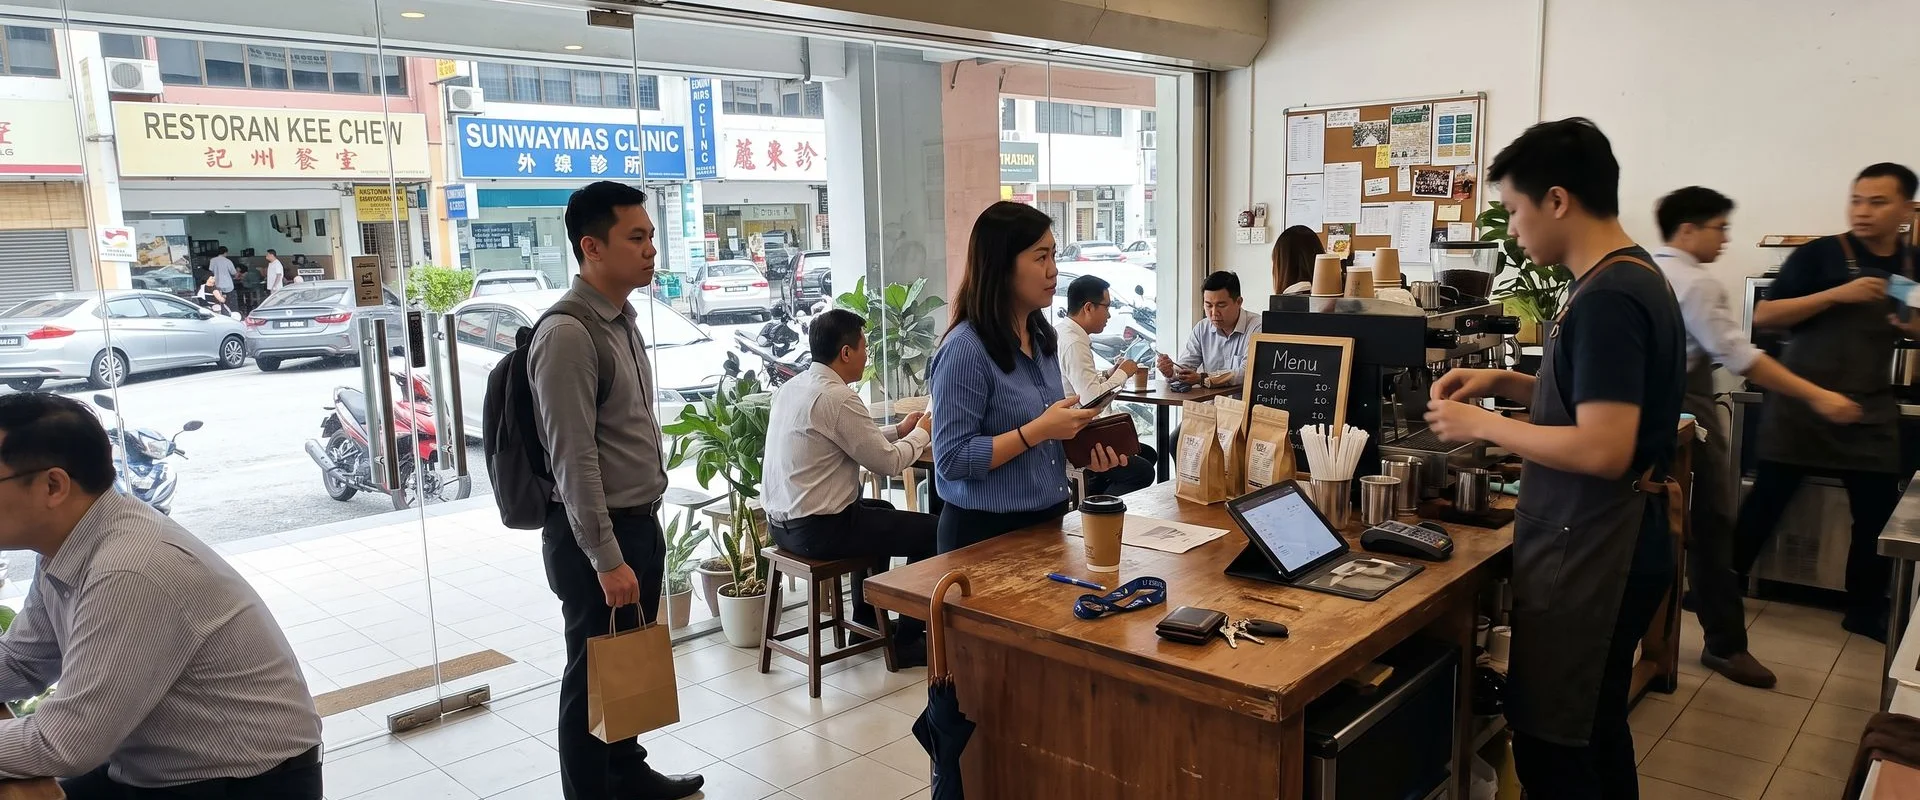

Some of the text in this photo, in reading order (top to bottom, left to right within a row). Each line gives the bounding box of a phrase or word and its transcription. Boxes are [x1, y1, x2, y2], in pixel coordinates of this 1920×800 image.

[143, 111, 403, 146] RESTORAN KEE CHEW
[466, 122, 680, 153] SUNWAYMAS CLINIC
[1272, 349, 1318, 372] Menu
[1257, 380, 1287, 391] Coffee
